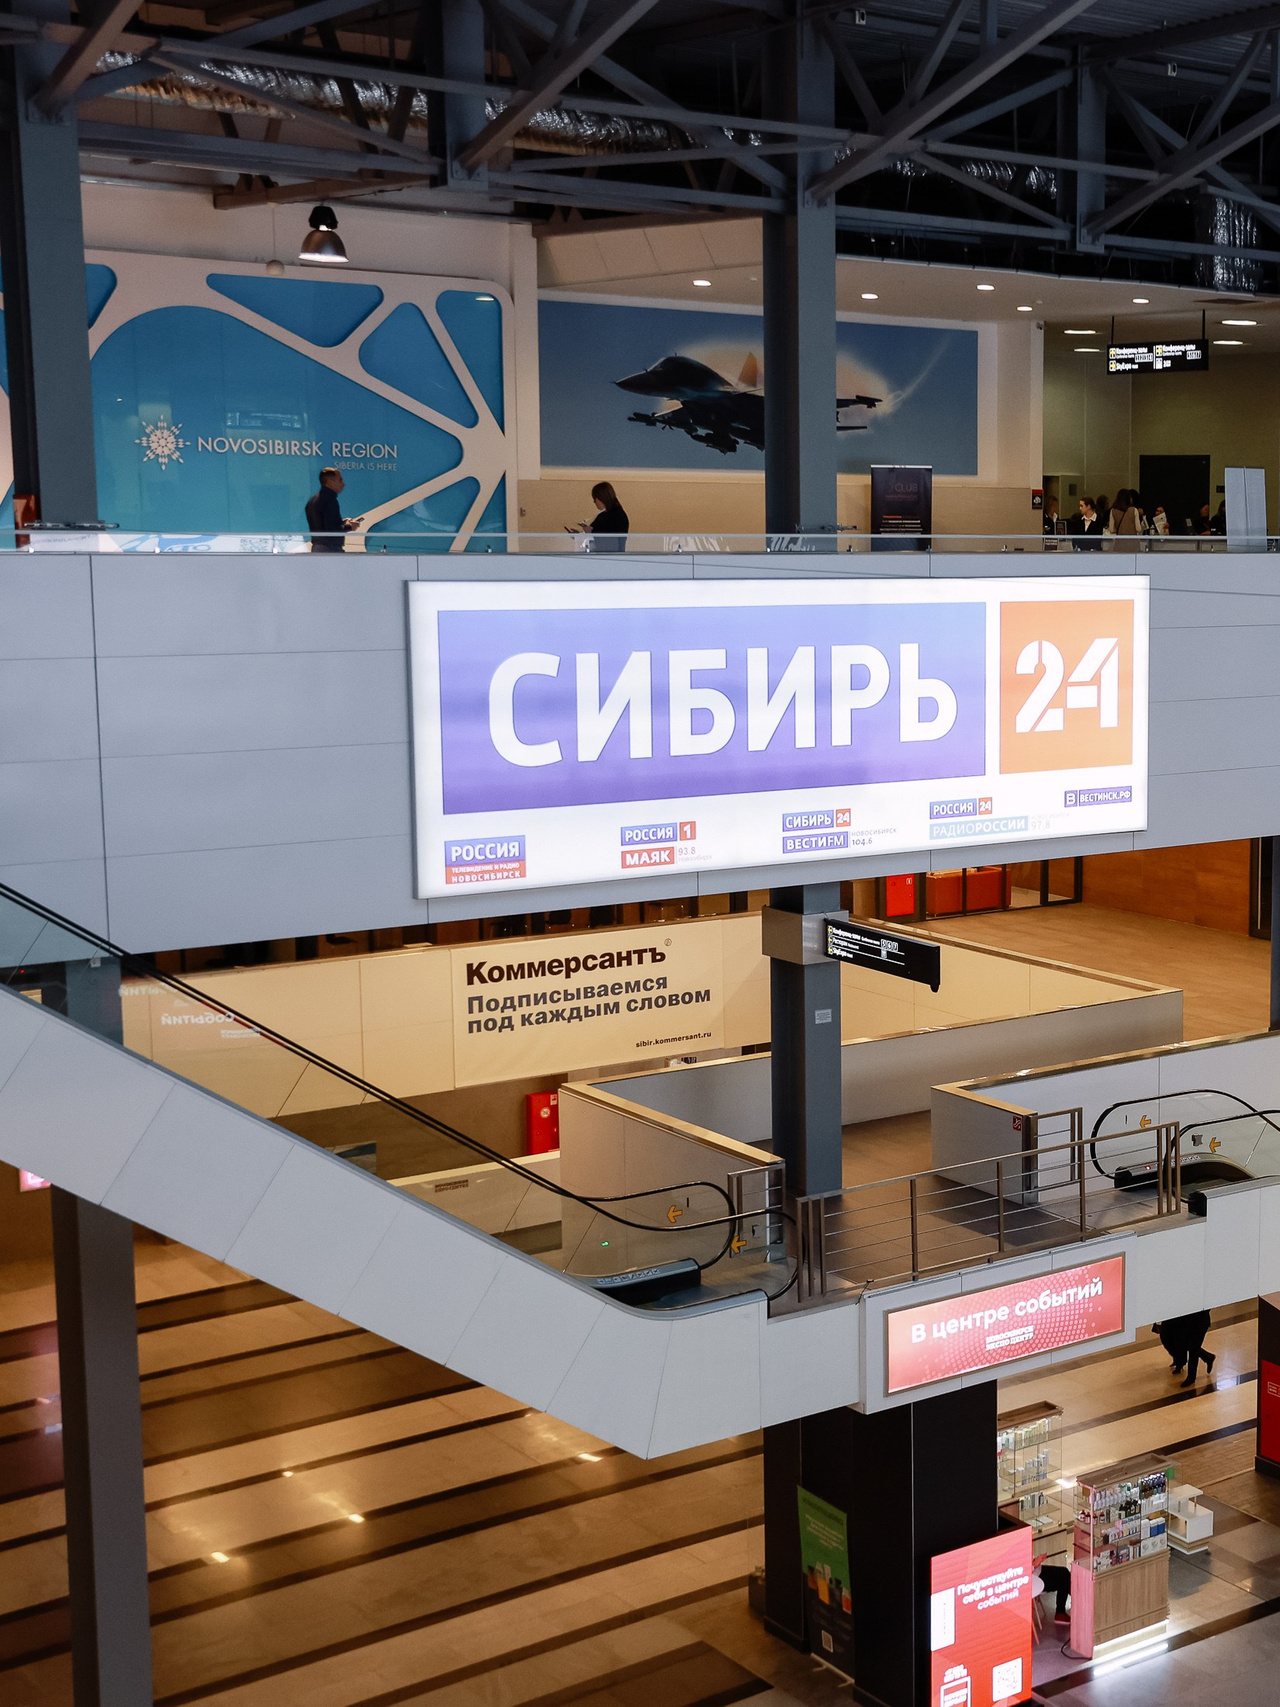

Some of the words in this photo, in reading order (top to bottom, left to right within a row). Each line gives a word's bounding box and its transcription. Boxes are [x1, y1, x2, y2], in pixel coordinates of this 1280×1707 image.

[197, 437, 323, 457] NOVOSIBIRSK
[332, 442, 398, 459] REGION
[334, 461, 365, 470] SIBERIA
[368, 463, 374, 471] IS
[377, 462, 398, 472] HERE
[488, 642, 959, 767] СИБИРЬ
[1014, 637, 1119, 733] 24
[1080, 789, 1132, 803] ВЕСТИНСК.РФ
[933, 801, 974, 817] РОССИЯ
[979, 800, 993, 814] 24
[785, 813, 833, 830] СИБИРЬ
[836, 811, 851, 825] 24
[625, 826, 674, 842] РОССИЯ
[683, 824, 691, 840] 1
[851, 827, 897, 837] НОВОСИБИРСК
[678, 846, 696, 856] 93.8
[786, 833, 844, 851] ВЕСТИFM
[852, 837, 873, 847] 104.6
[451, 841, 520, 862] РОССИЯ
[625, 848, 671, 866] МАЯК
[452, 871, 521, 883] НОВОСИБИРСК
[466, 946, 666, 986] Коммерсантъ
[467, 976, 668, 1015] Подписываемся
[468, 1014, 515, 1034] под
[520, 1001, 620, 1027] каждым
[626, 989, 711, 1013] словом
[635, 1031, 712, 1048] sibir.kommersant.ru
[911, 1324, 927, 1344] В
[932, 1306, 1010, 1339] центре
[1014, 1277, 1104, 1316] событий
[957, 1566, 1024, 1597] Почувствуйте
[962, 1591, 986, 1605] себя
[987, 1588, 994, 1597] в
[994, 1575, 1030, 1595] центре
[977, 1588, 1020, 1610] событий
